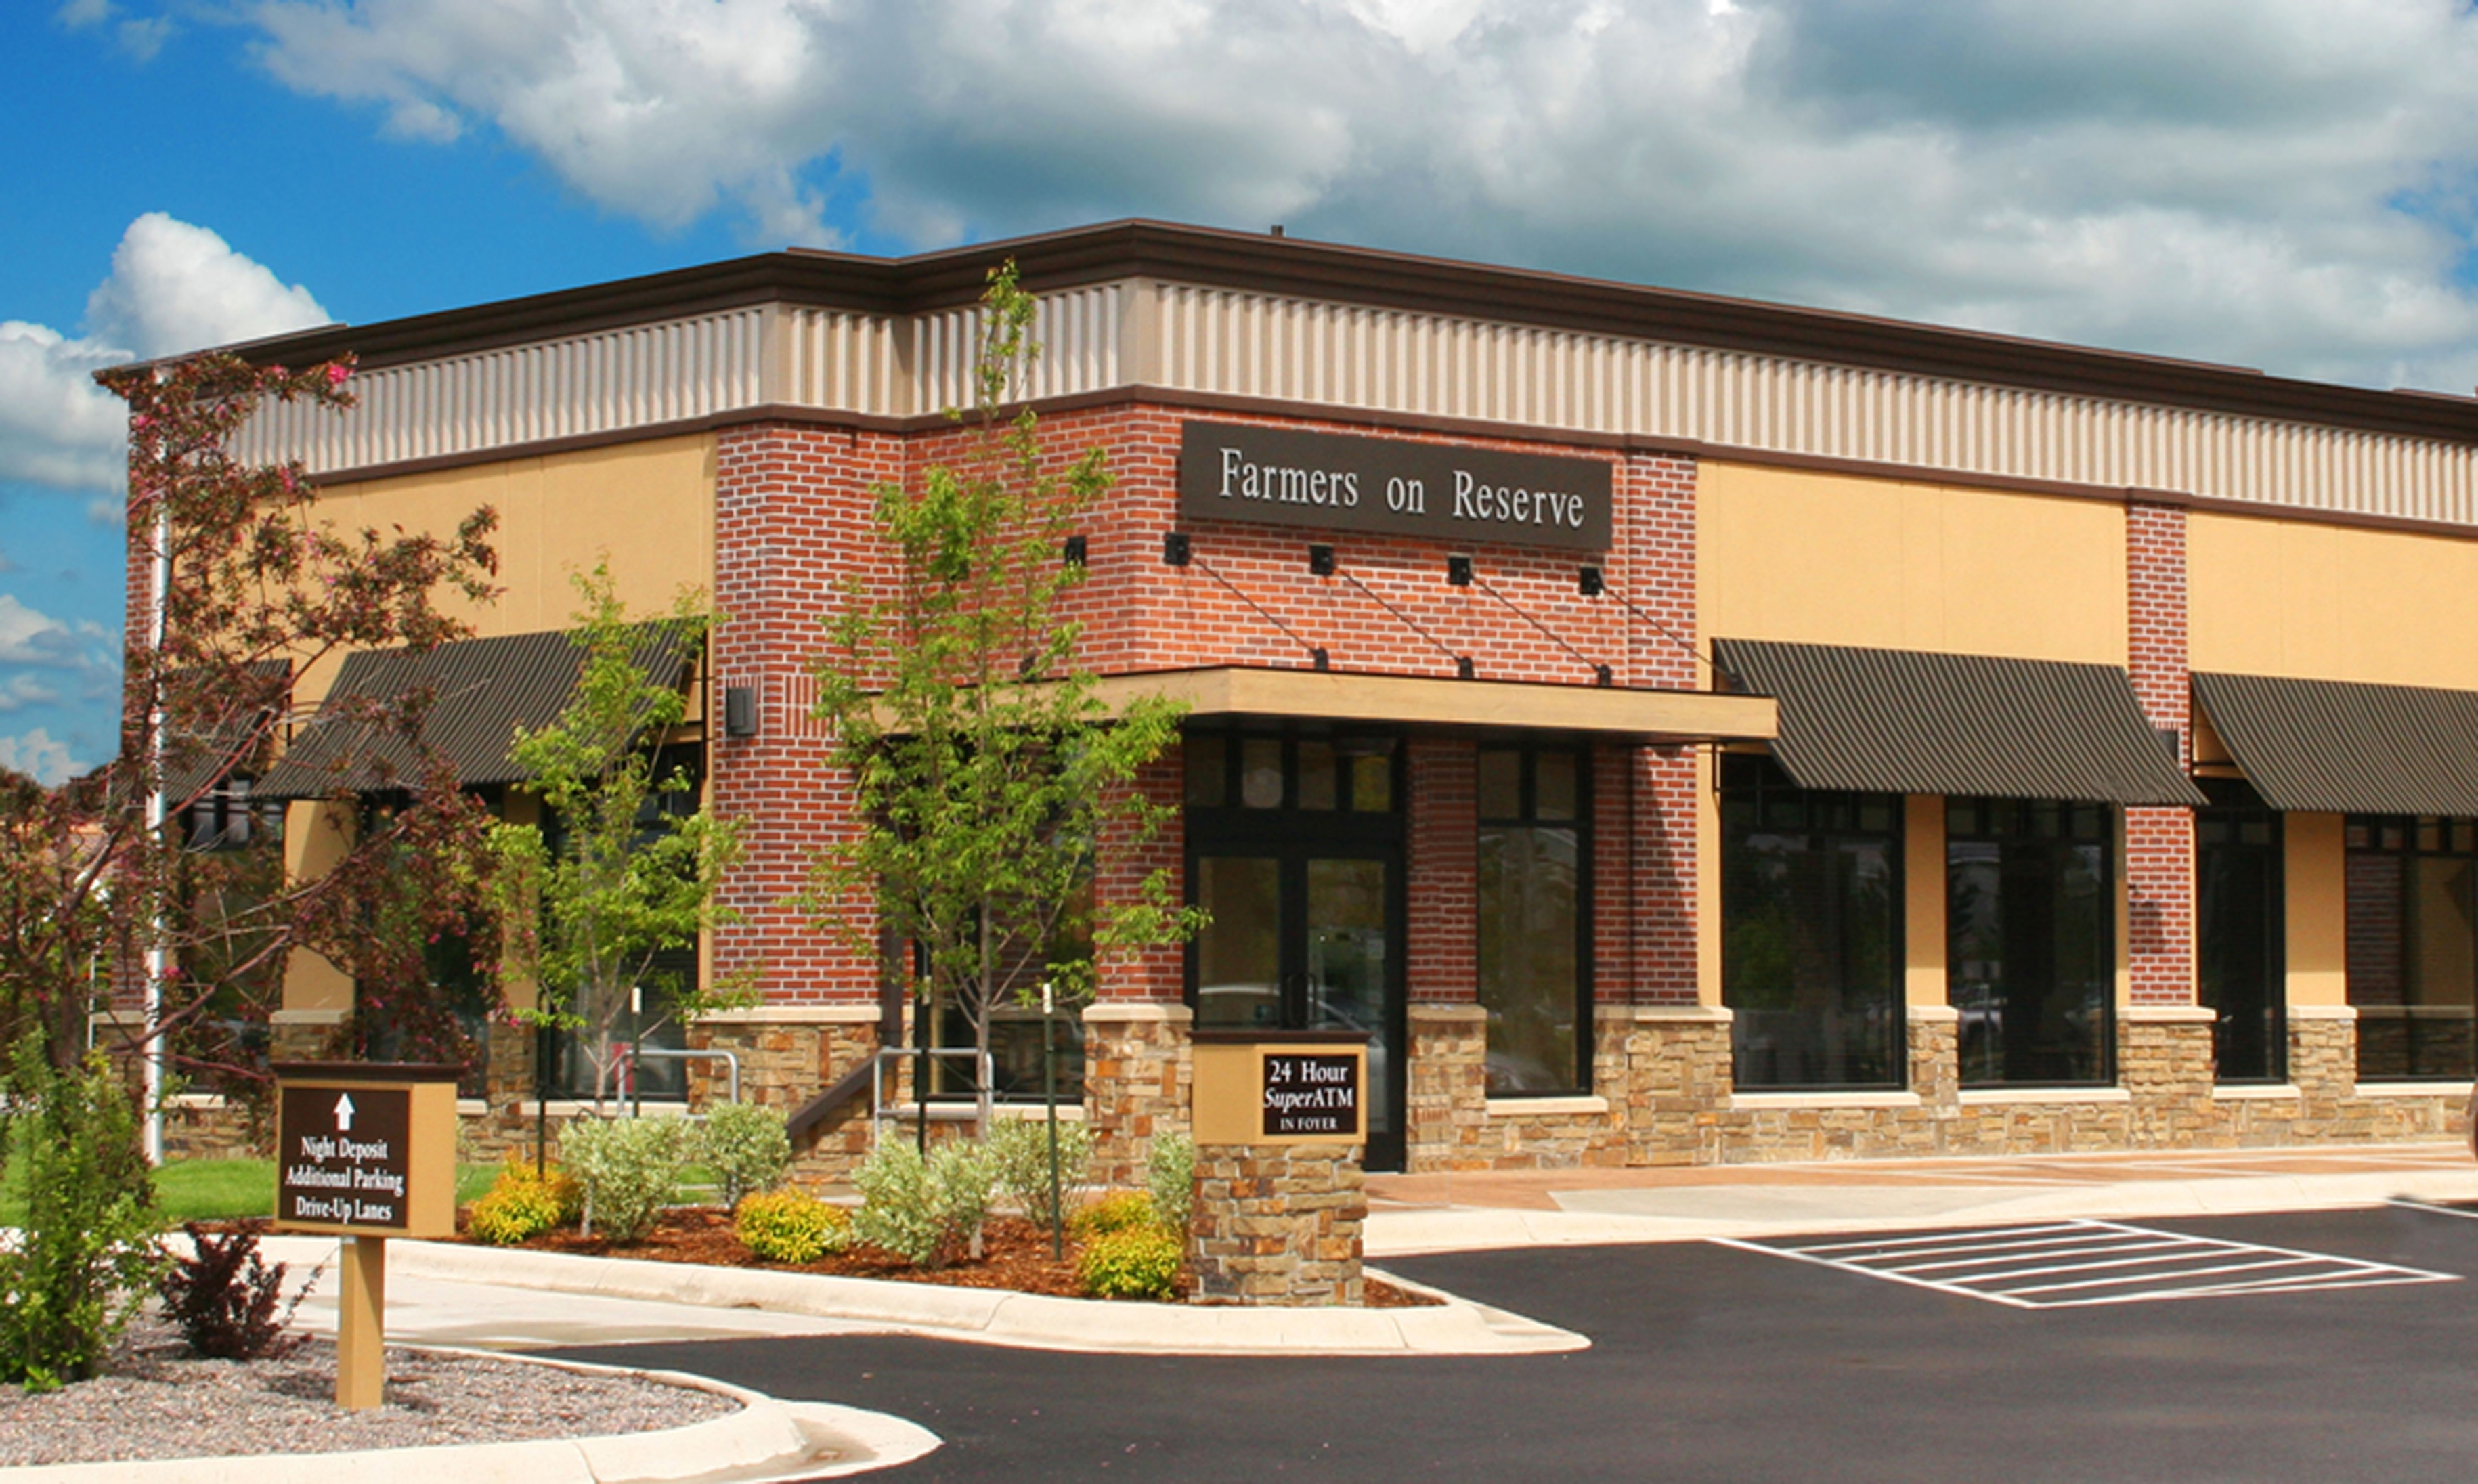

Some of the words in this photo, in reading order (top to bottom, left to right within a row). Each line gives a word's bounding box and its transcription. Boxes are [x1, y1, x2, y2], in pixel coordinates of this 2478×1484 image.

[1220, 448, 1359, 507] Farmers
[1386, 475, 1425, 515] on
[1452, 470, 1584, 528] Reserve
[1269, 1060, 1292, 1083] 24
[1301, 1060, 1348, 1083] Hour
[1264, 1087, 1353, 1114] SuperATM
[1280, 1118, 1294, 1130] IN
[1297, 1117, 1338, 1130] FOYER
[301, 1136, 336, 1163] Night
[339, 1137, 388, 1164] Deposit
[285, 1165, 351, 1188] Additional
[354, 1168, 404, 1197] Parking
[295, 1196, 352, 1225] Drive-Up
[355, 1199, 393, 1220] Lanes
